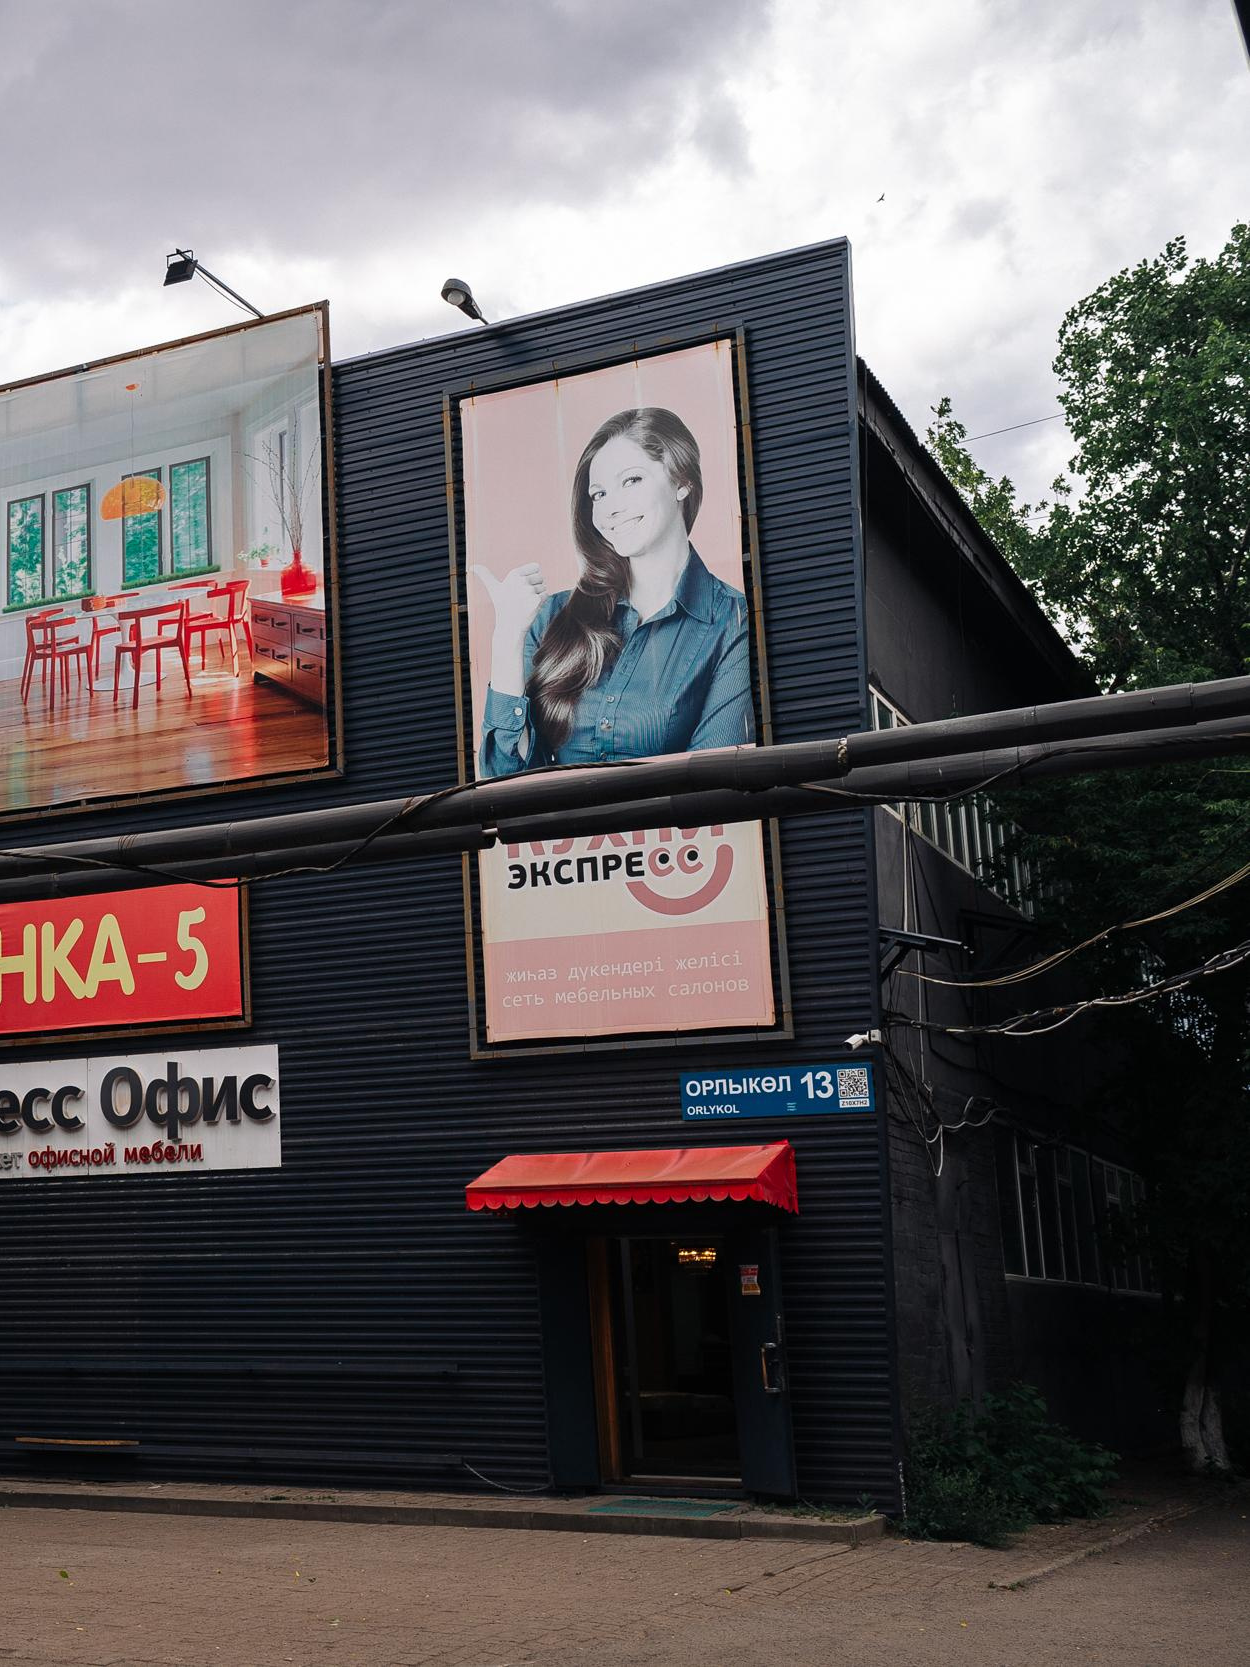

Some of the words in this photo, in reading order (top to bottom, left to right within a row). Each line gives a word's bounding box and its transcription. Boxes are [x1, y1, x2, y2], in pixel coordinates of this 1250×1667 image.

[507, 844, 705, 889] ЭКСПРЕСС
[676, 950, 743, 970] желісі
[502, 993, 544, 1008] сеть
[555, 984, 655, 1004] мебельных
[668, 978, 749, 997] салонов
[685, 1076, 792, 1097] ОРЛЫКӨЛ
[800, 1071, 834, 1099] 13
[100, 1061, 277, 1144] Офис
[687, 1103, 740, 1116] ORLYKOL
[28, 1142, 116, 1172] офисной
[124, 1139, 204, 1165] мебели
